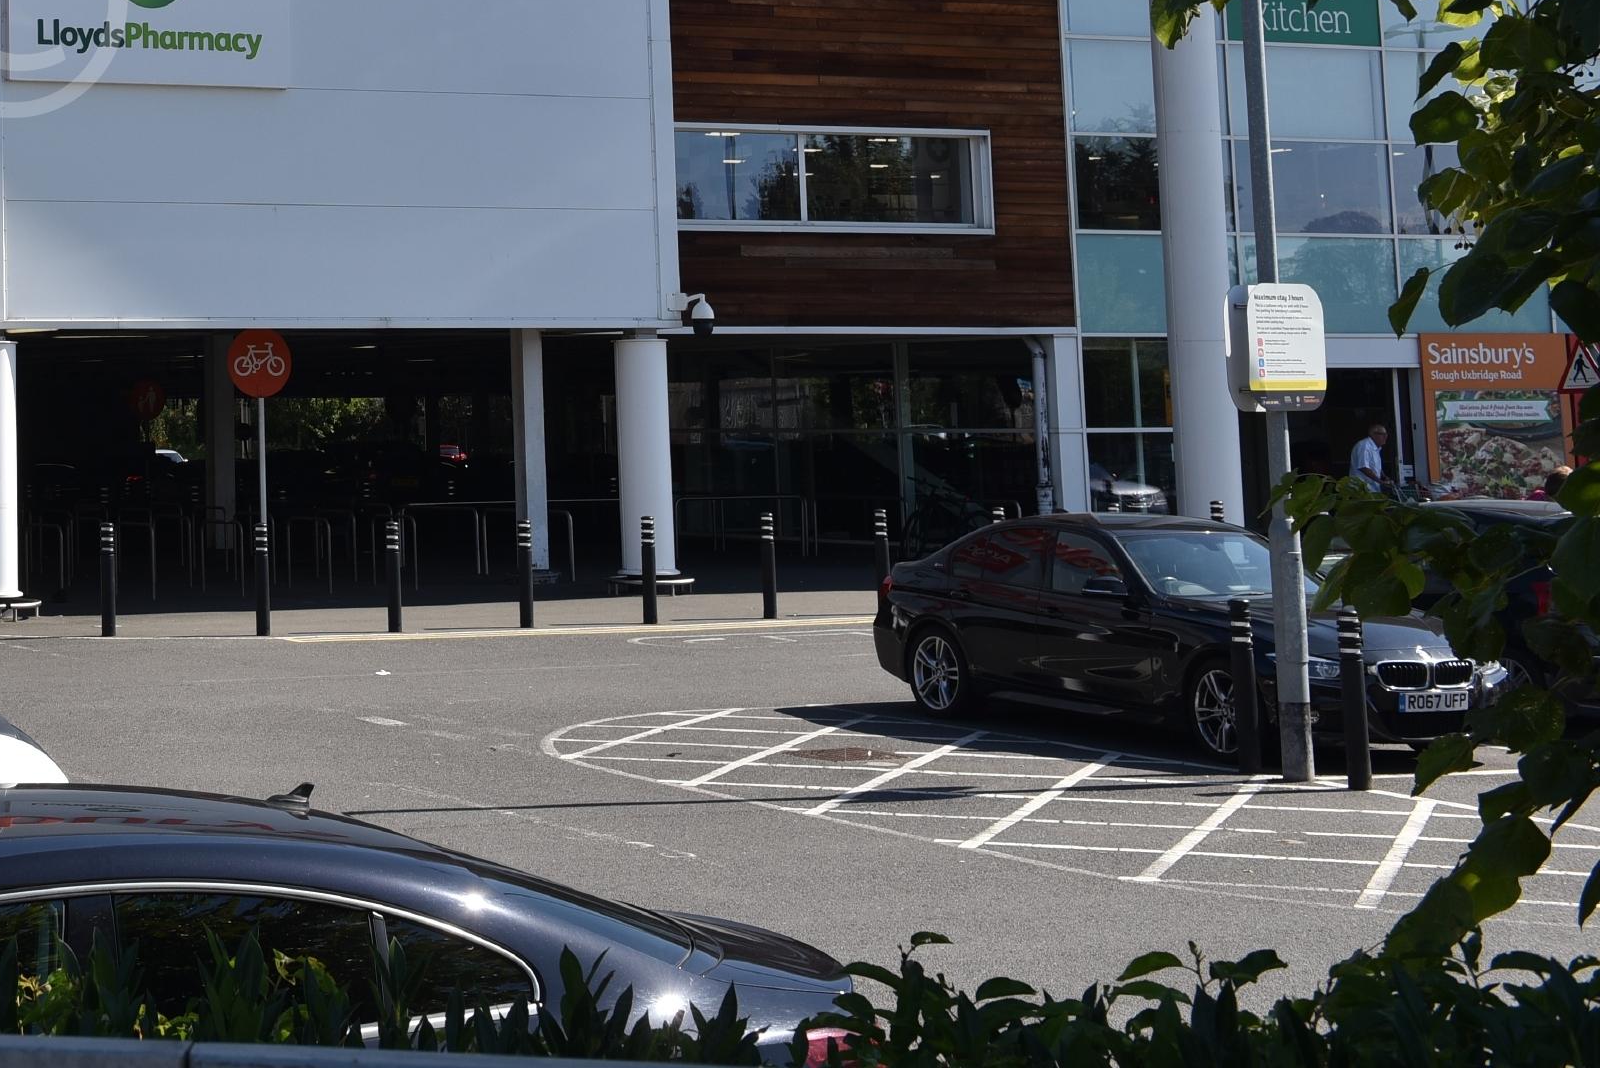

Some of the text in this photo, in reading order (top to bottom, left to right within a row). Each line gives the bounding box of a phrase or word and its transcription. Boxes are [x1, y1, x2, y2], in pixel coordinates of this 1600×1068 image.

[37, 18, 263, 60] LloydsPharmacy
[1427, 342, 1536, 369] Sainsbury's
[1431, 370, 1522, 382] Slough Uxbridge Road
[1444, 693, 1467, 709] UFP
